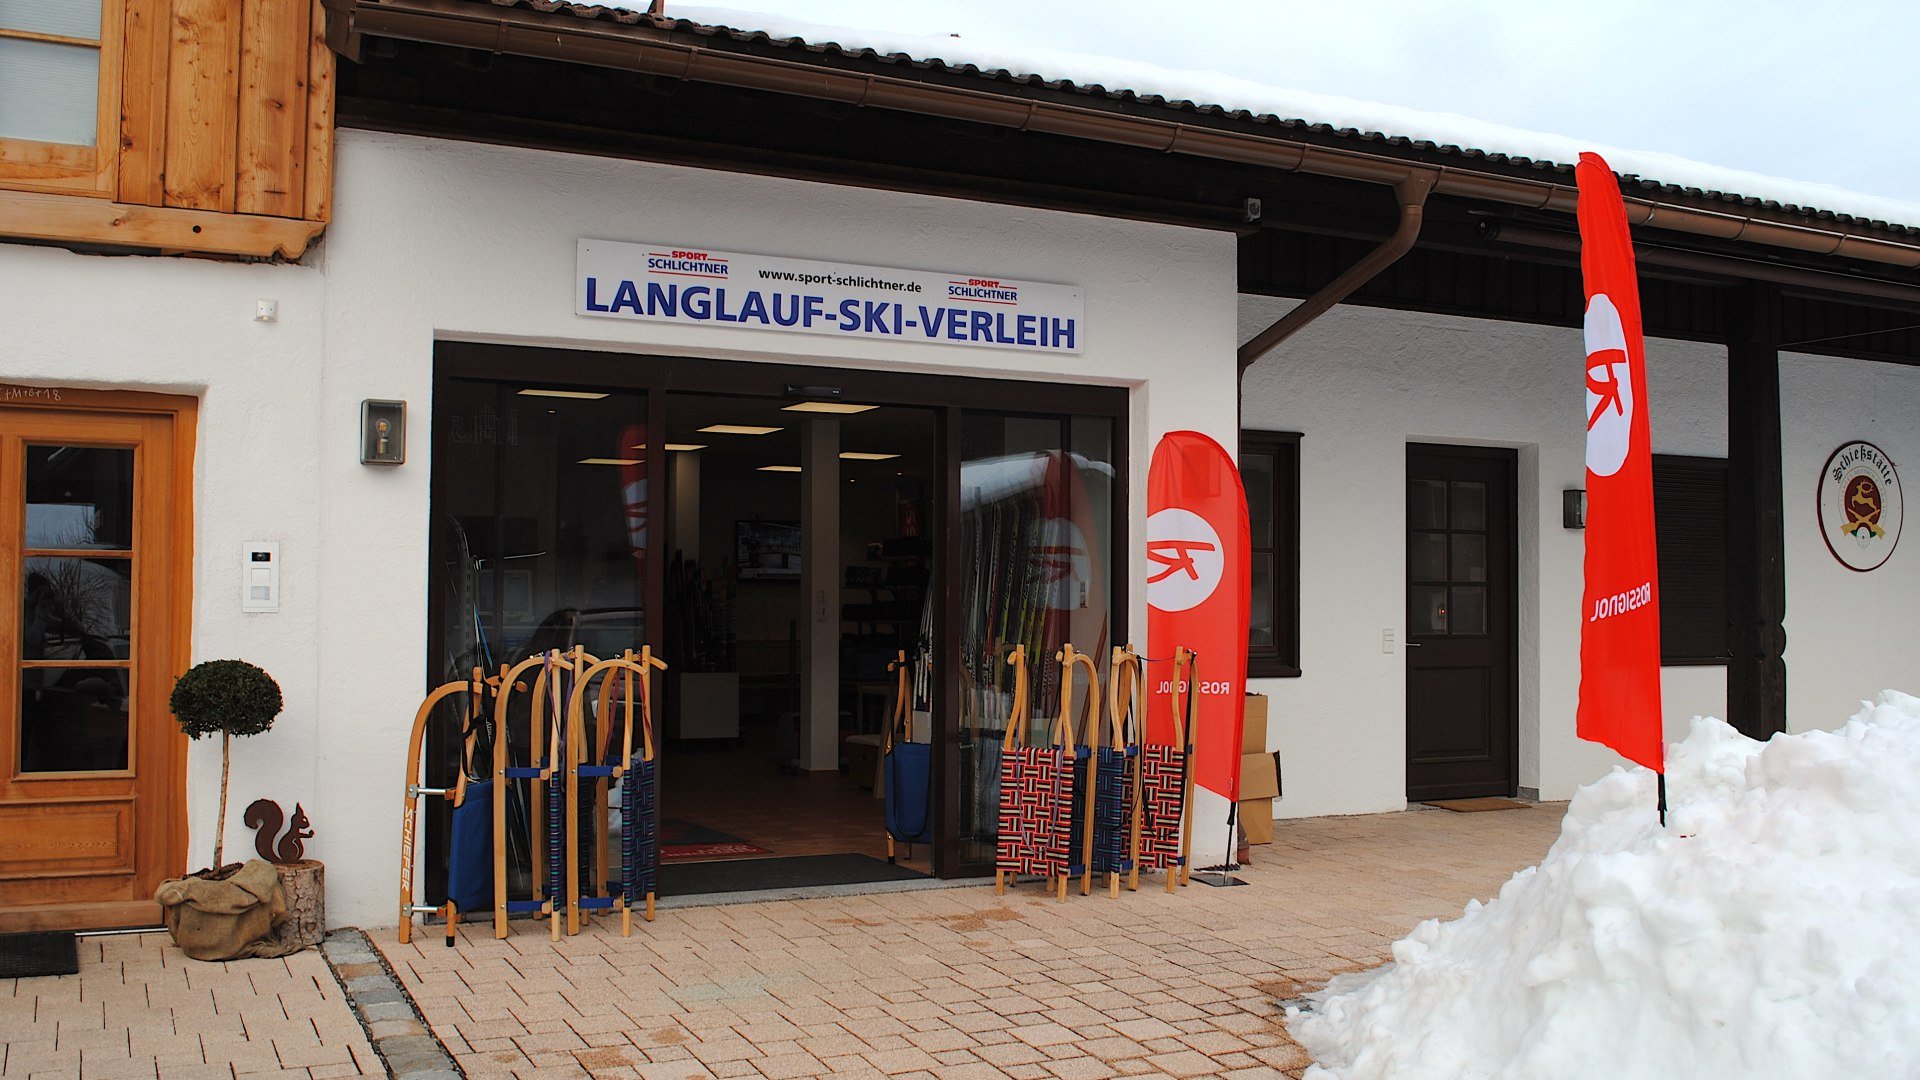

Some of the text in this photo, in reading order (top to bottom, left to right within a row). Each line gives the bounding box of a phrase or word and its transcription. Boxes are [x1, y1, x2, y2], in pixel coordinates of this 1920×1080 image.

[671, 250, 708, 261] SPORT
[648, 258, 729, 275] SCHLICHTNER
[758, 269, 923, 293] www.sport-schlichtner.de
[968, 278, 1000, 289] SPORT
[948, 286, 1018, 301] SCHLICHTNER
[586, 276, 1076, 349] LANGLAUF-SKI-VERLEIH
[1832, 445, 1892, 484] Schießstätte
[401, 805, 415, 892] SCHIEFER
